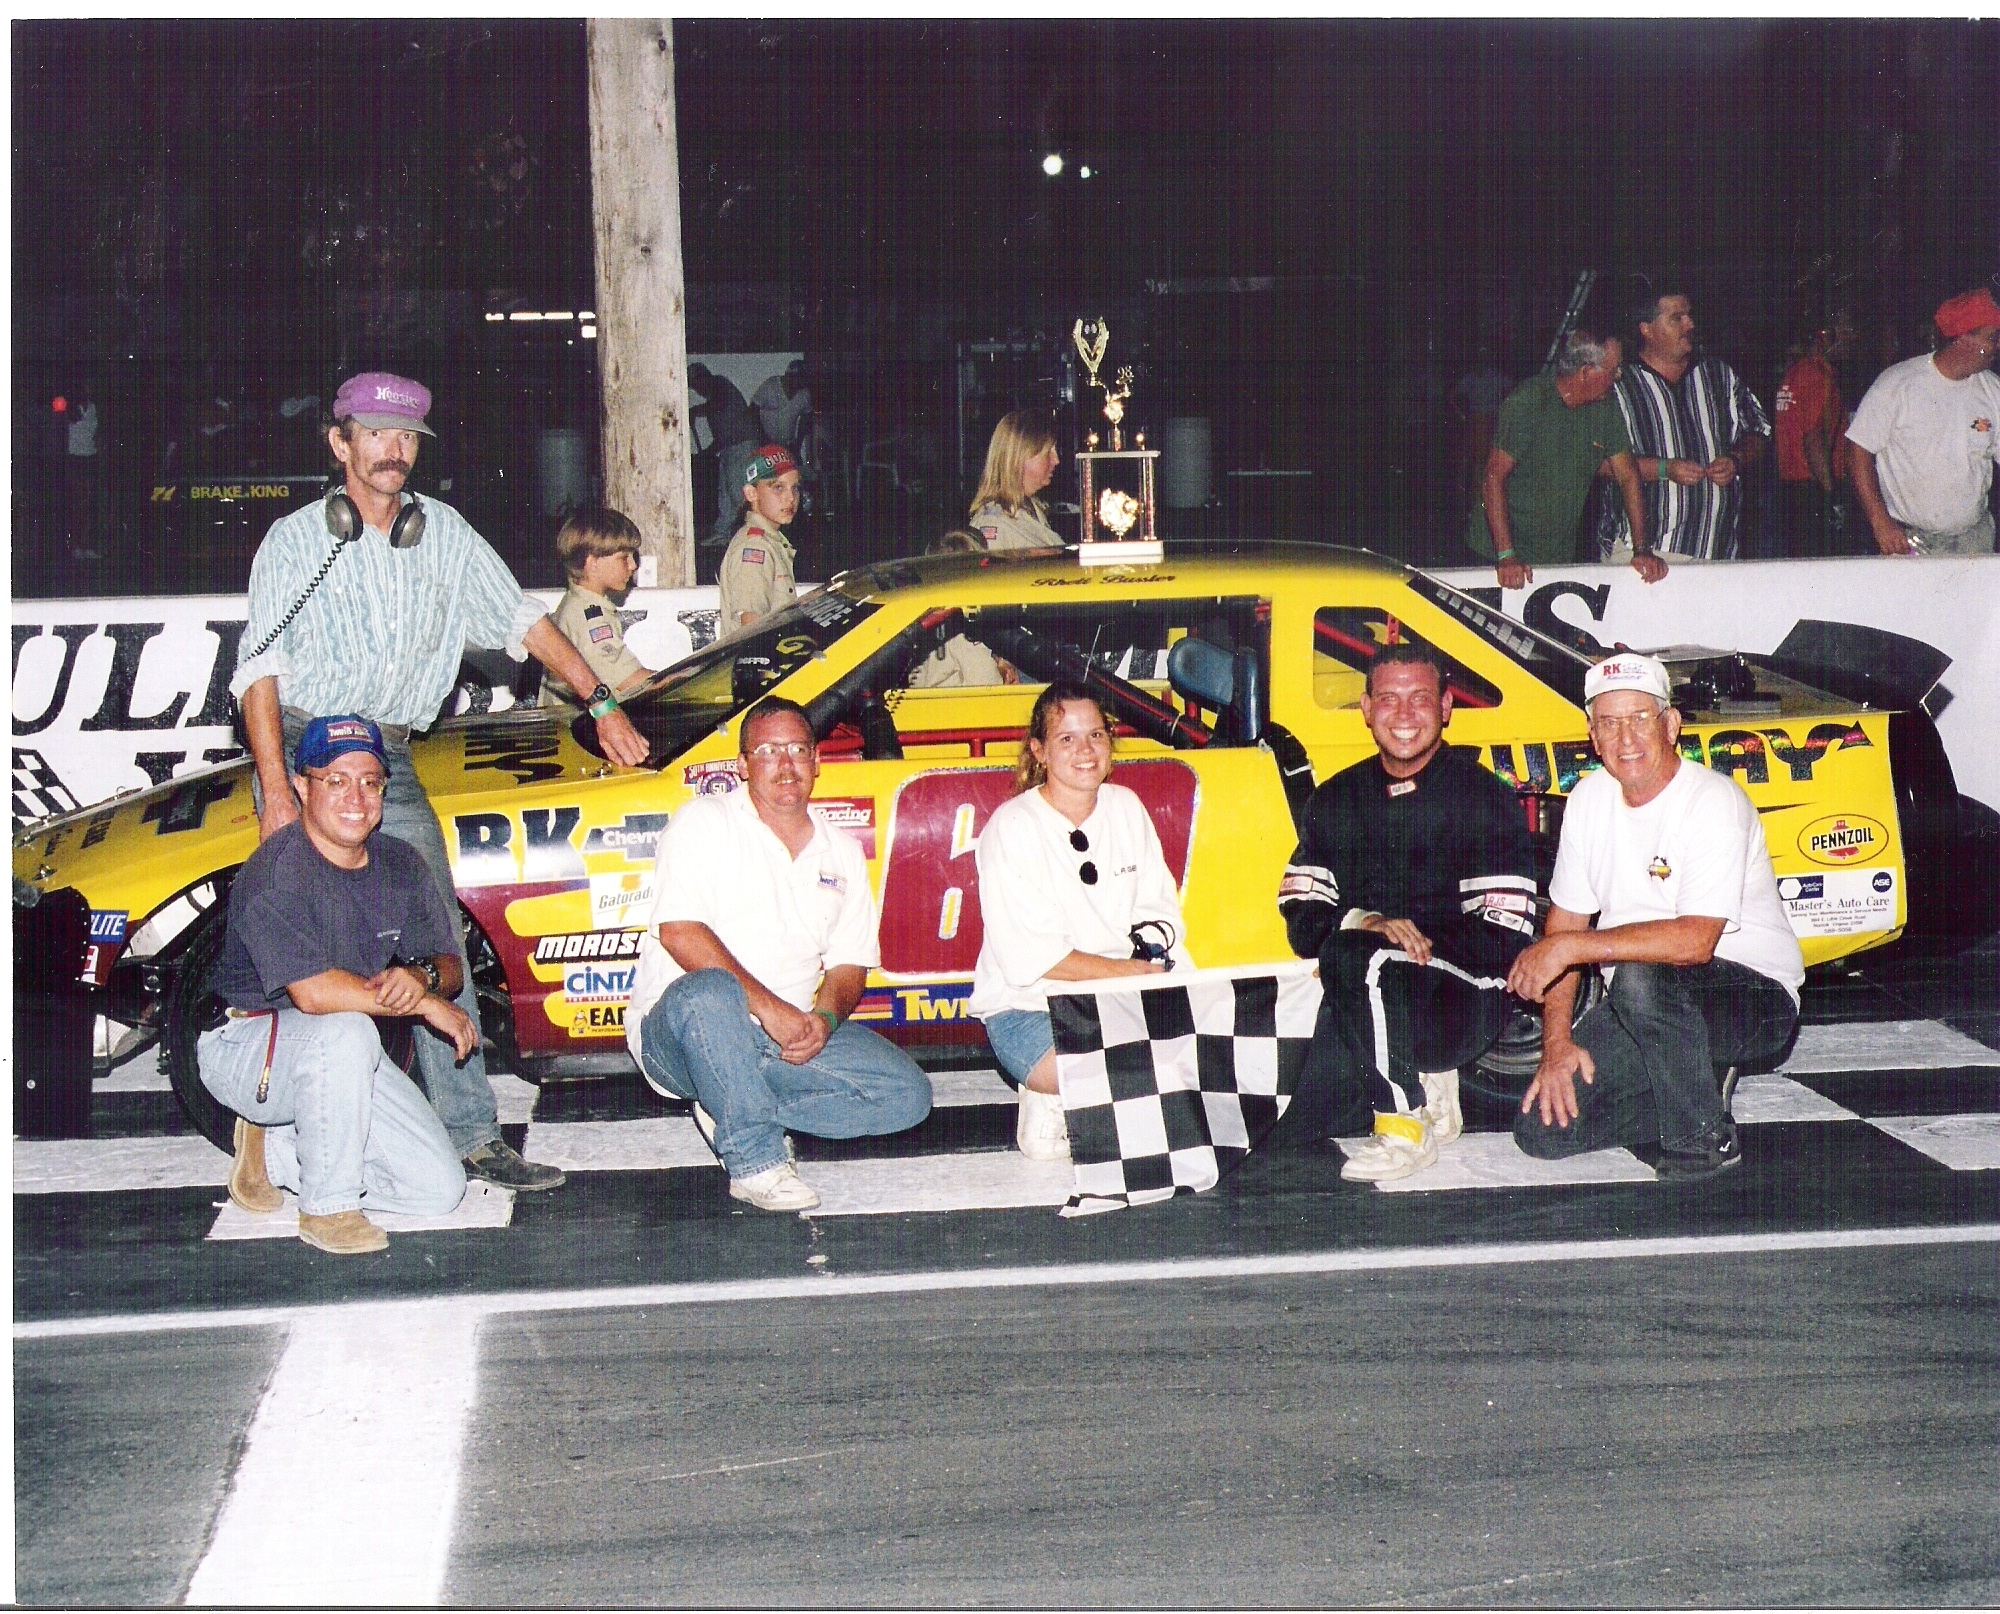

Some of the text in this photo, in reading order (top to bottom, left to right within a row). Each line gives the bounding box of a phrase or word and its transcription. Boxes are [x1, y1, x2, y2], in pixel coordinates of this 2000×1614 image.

[1603, 662, 1622, 676] RK
[815, 807, 872, 823] Racing
[1811, 827, 1875, 851] PENNZOIL
[1873, 878, 1891, 887] ASE
[1487, 896, 1506, 907] RJS
[1789, 895, 1890, 911] Master's Auto Care
[90, 914, 127, 936] LITE
